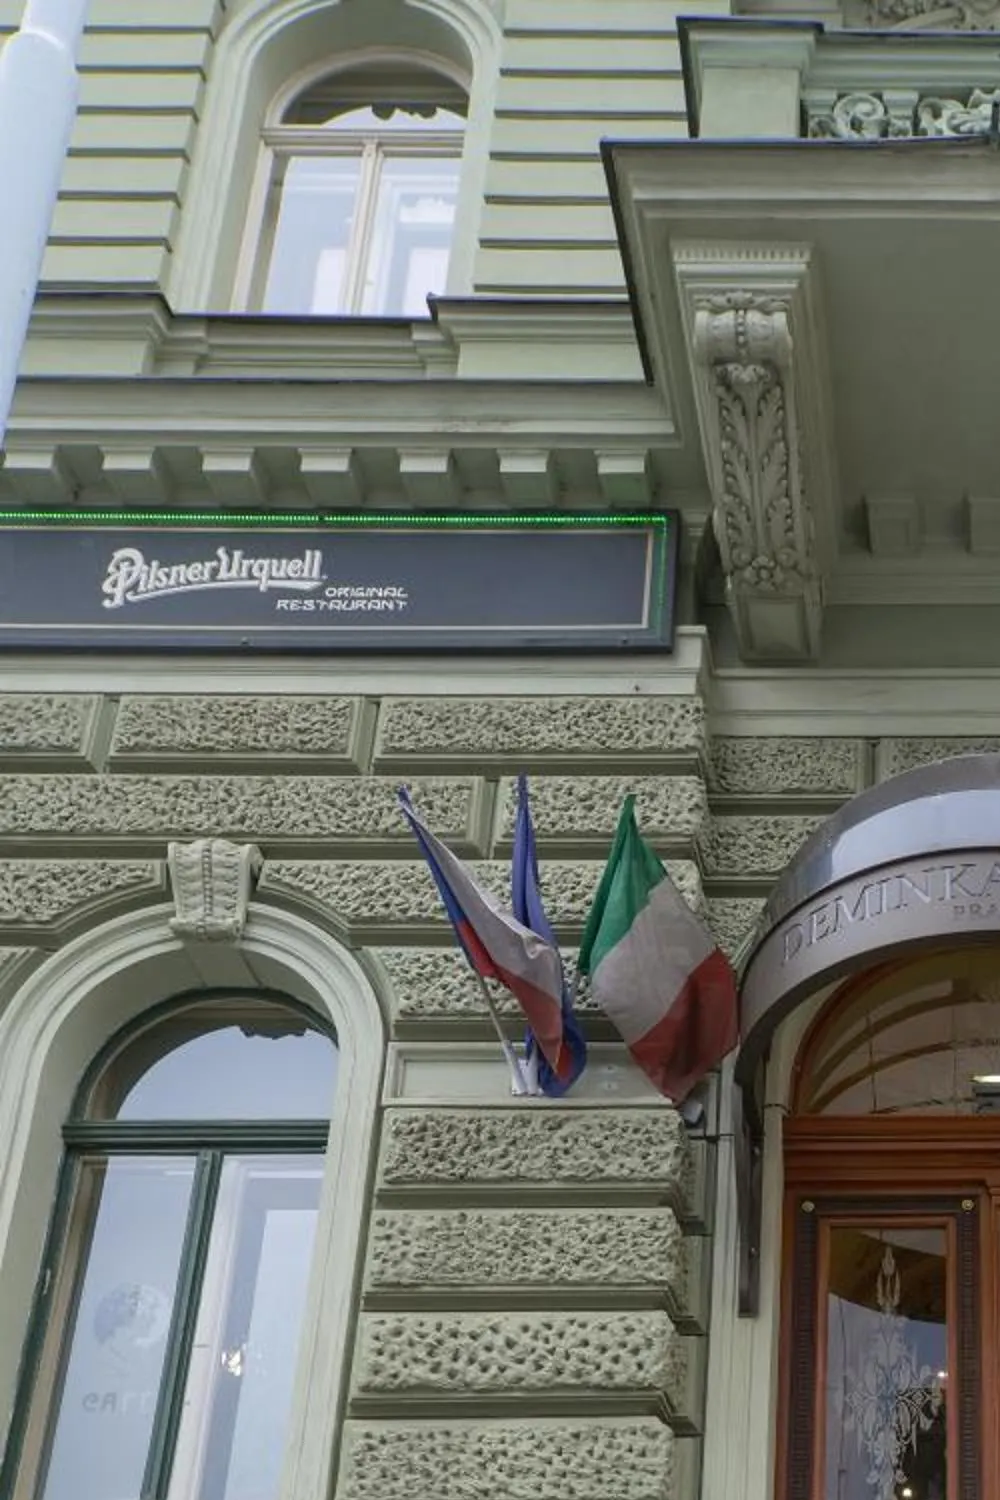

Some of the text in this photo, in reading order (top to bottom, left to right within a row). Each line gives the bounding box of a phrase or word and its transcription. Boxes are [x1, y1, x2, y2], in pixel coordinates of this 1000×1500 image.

[102, 546, 323, 608] Pilsner Urquell
[325, 586, 409, 599] ORIGINAL
[275, 599, 408, 612] RESTAURANT
